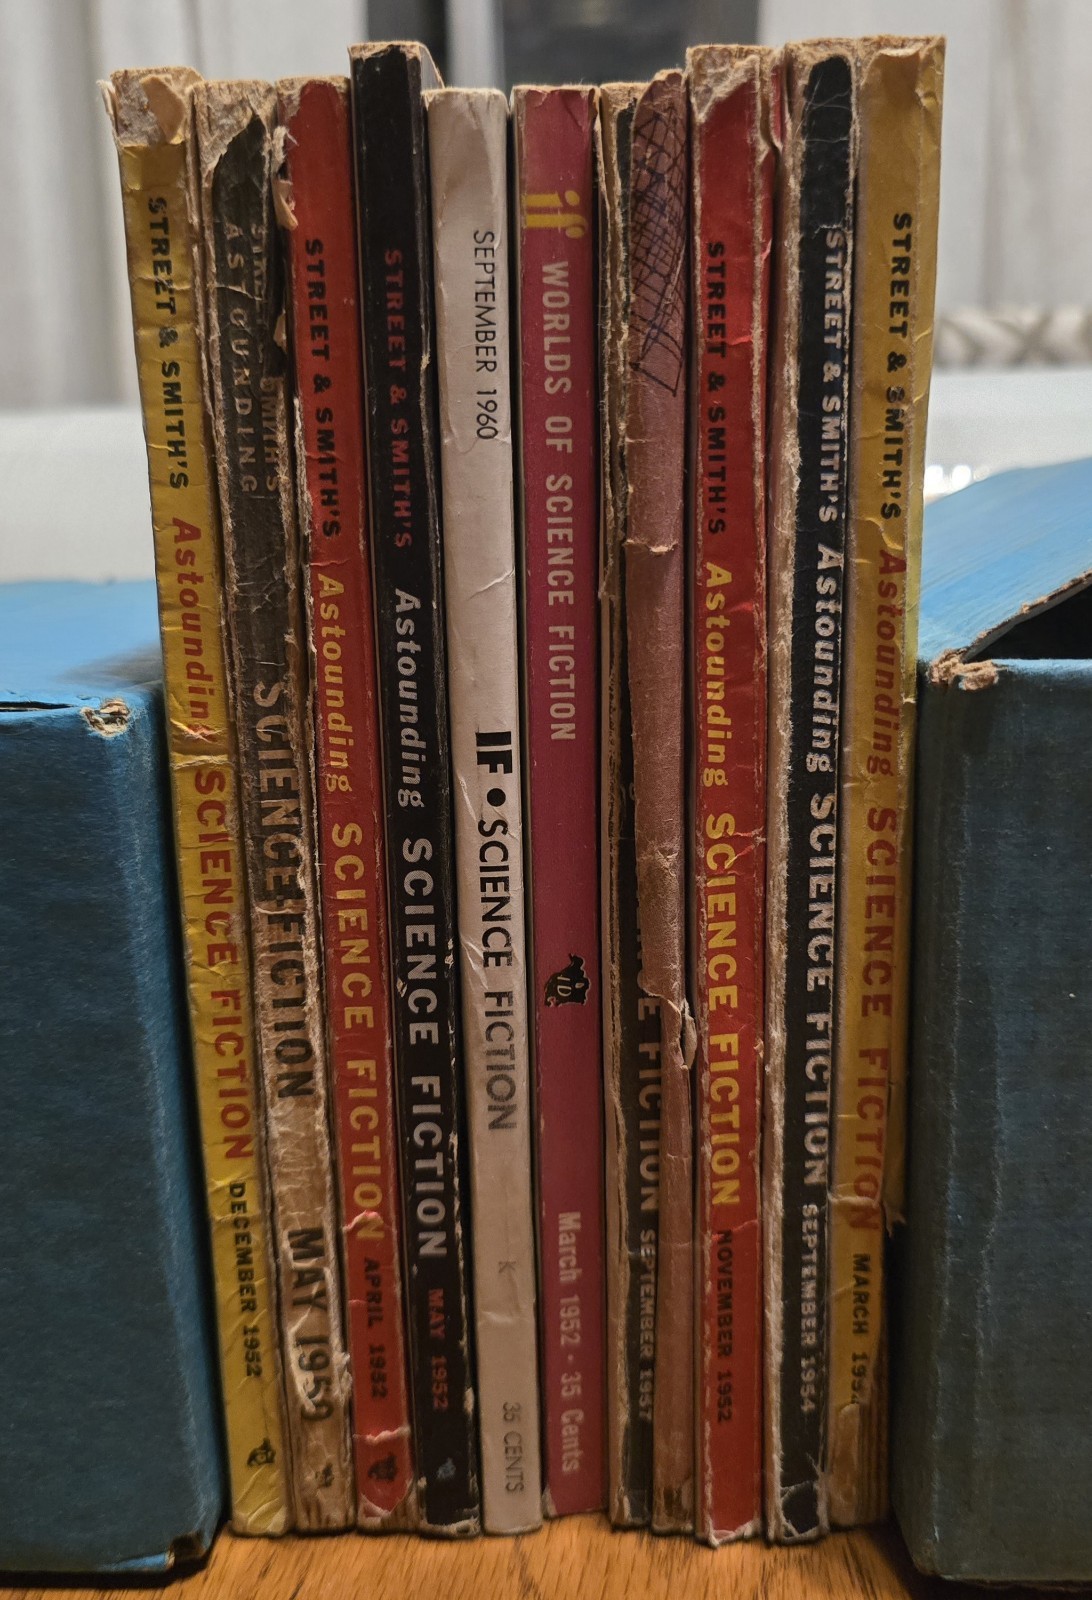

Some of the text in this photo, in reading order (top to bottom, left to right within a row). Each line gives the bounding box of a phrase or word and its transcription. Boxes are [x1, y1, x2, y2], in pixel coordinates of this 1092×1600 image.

[148, 197, 176, 316] STREET
[524, 190, 588, 239] if
[888, 213, 912, 338] STREET
[159, 325, 179, 348] &
[474, 230, 499, 440] SEPTEMBER 1960
[823, 229, 844, 349] STREET
[161, 361, 189, 490] SMITH'S
[822, 363, 841, 381] &
[886, 353, 906, 372] &
[542, 261, 576, 741] WORLDS OF SCIENCE FICTION
[818, 395, 841, 523] SMITH'S
[880, 387, 905, 520] SMITH'S
[806, 544, 843, 773] Astounding
[866, 550, 908, 777] Astounding
[195, 769, 236, 966] SCIENCE
[305, 238, 388, 1398] STREET & SMITH'S Astounding SCIENCE FICTION APRIL 1952
[384, 250, 450, 1410] STREET & SMITH'S Astounding SCIENCE FICTION MAY 1952
[703, 240, 739, 1424] STREET & SMITH'S Astounding SCIENCE FICTION NOVEMBER 1952
[475, 730, 518, 1132] IF SCIENCE FICTION
[806, 792, 836, 992] SCIENCE
[860, 807, 898, 1018] SCIENCE
[210, 989, 253, 1160] FICTION
[803, 1013, 832, 1186] FICTION
[851, 1047, 889, 1229] FICTION
[229, 1182, 257, 1313] DECEMBER
[287, 1227, 327, 1315] MAY
[639, 1229, 656, 1358] SEPTEMBER
[800, 1204, 818, 1346] SEPTEMBER
[852, 1253, 871, 1335] MARCH
[242, 1325, 263, 1377] 1952
[558, 1211, 584, 1474] March 1952 35 Cents
[502, 1401, 524, 1494] 35 CENTS
